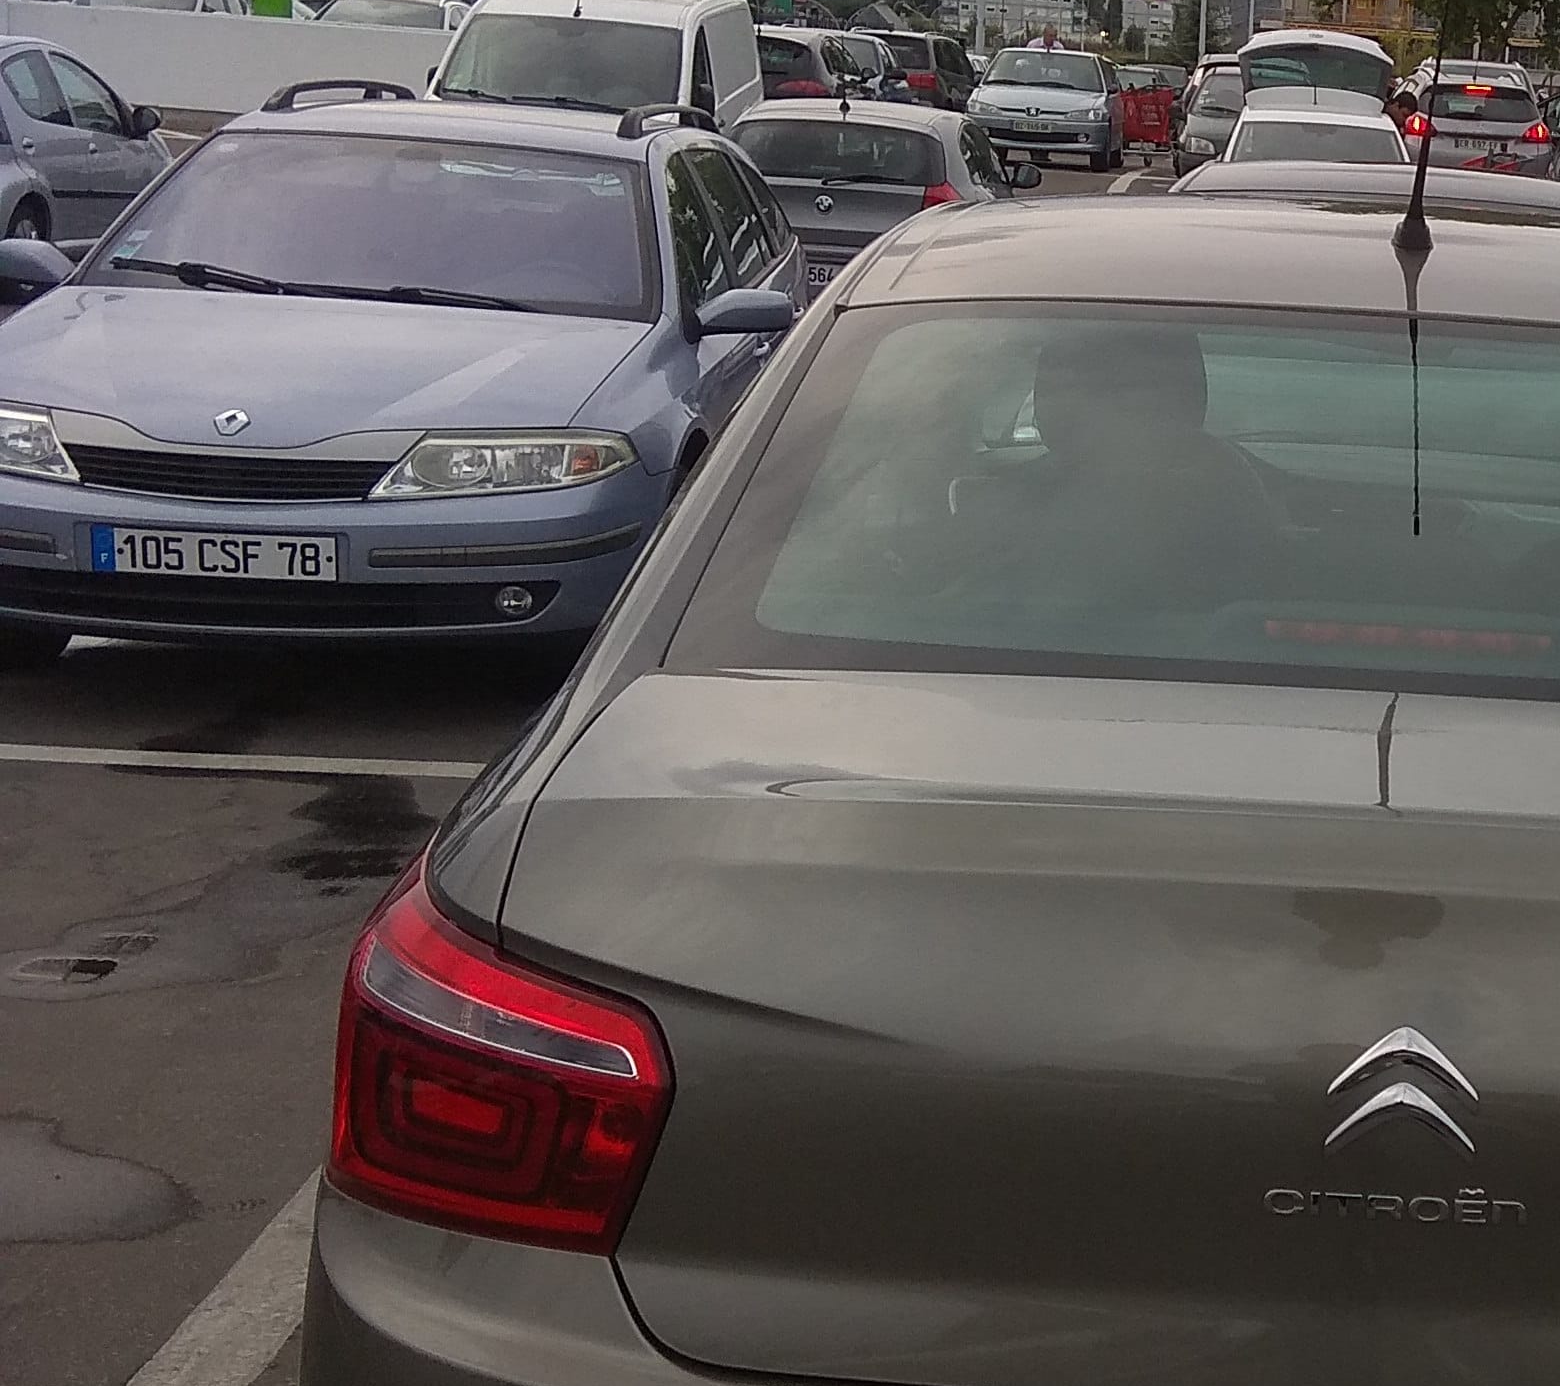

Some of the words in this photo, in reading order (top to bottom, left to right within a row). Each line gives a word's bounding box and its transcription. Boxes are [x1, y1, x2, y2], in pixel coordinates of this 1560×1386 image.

[123, 534, 184, 570] 105
[198, 538, 262, 574] CSF
[277, 541, 321, 576] 78
